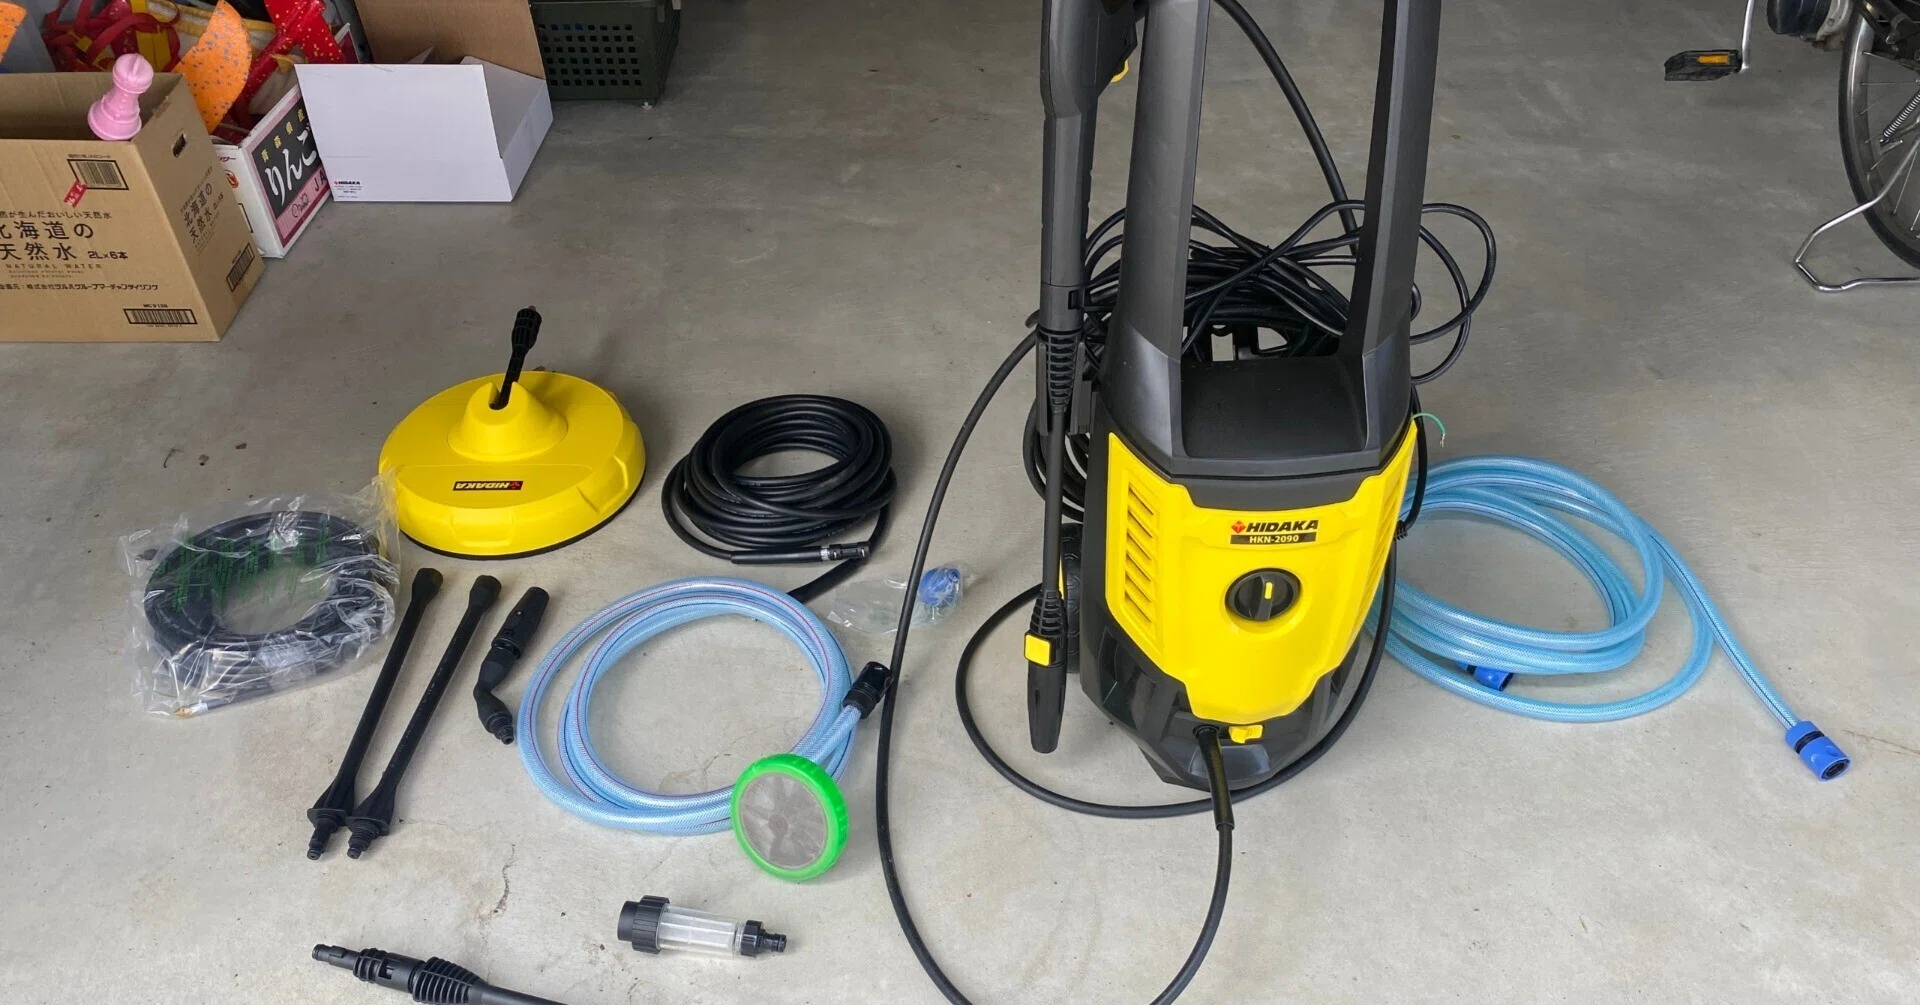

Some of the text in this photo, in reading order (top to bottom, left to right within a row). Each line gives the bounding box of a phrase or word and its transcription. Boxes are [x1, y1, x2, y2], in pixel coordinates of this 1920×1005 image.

[265, 122, 317, 206] りんご
[184, 183, 212, 227] 北海道の
[189, 207, 212, 243] 天然水
[0, 242, 78, 261] 天然水
[1245, 519, 1319, 533] HIDAKA
[1248, 534, 1299, 544] HKN-2090
